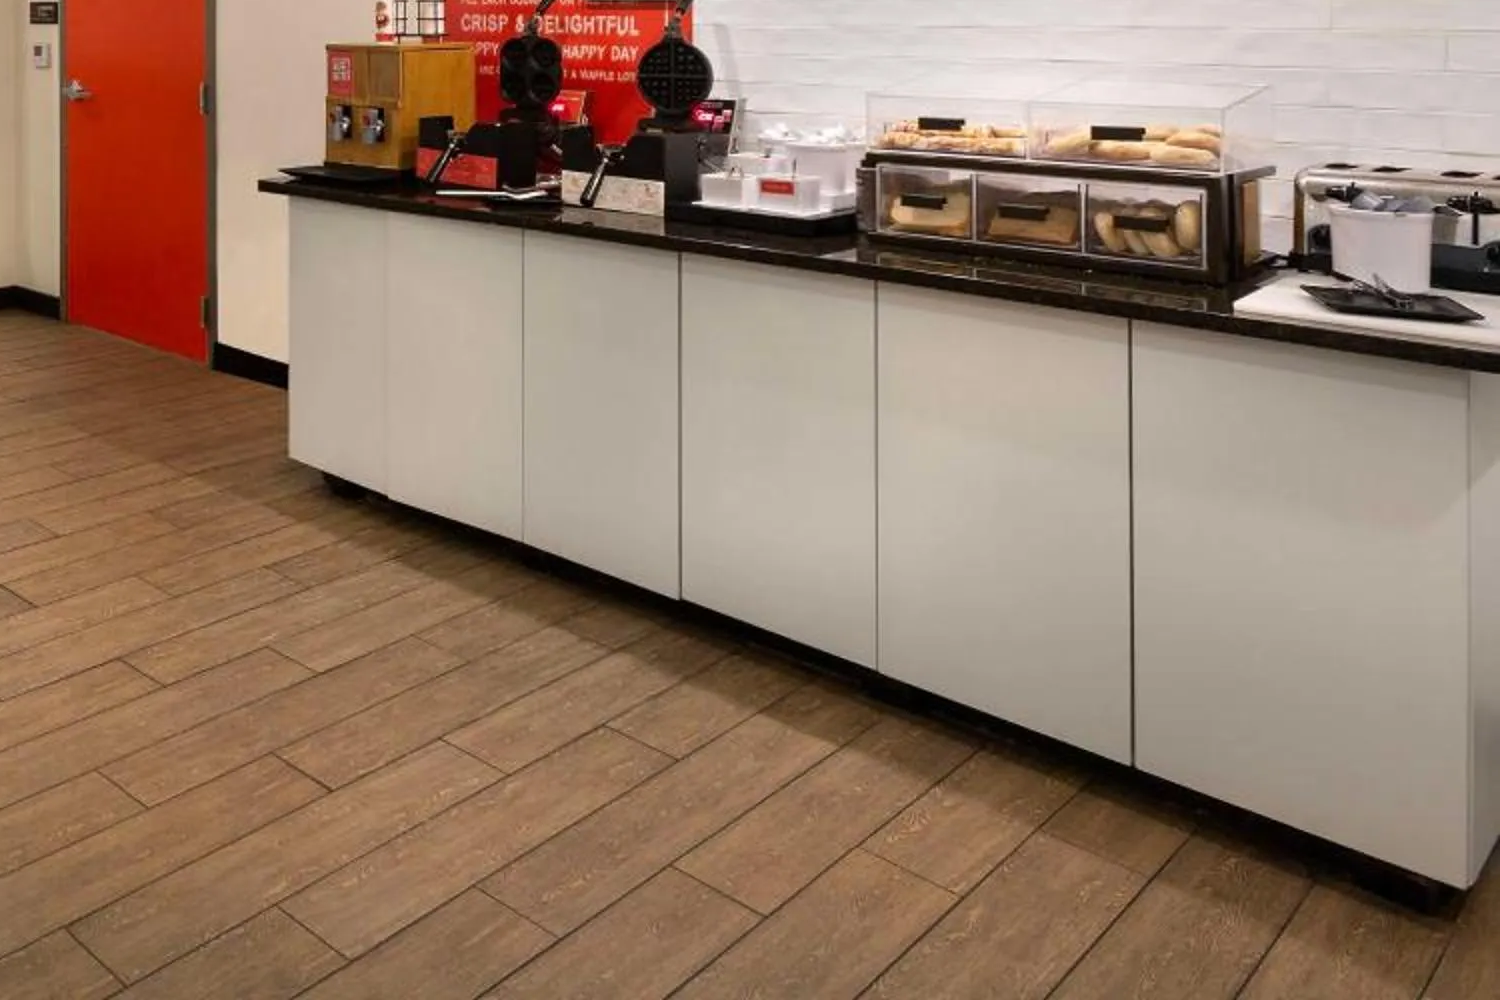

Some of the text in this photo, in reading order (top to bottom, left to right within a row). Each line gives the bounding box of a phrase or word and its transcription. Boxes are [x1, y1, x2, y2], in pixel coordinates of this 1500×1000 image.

[460, 13, 509, 33] CRISP
[475, 41, 639, 64] PPY HAPPY DAY
